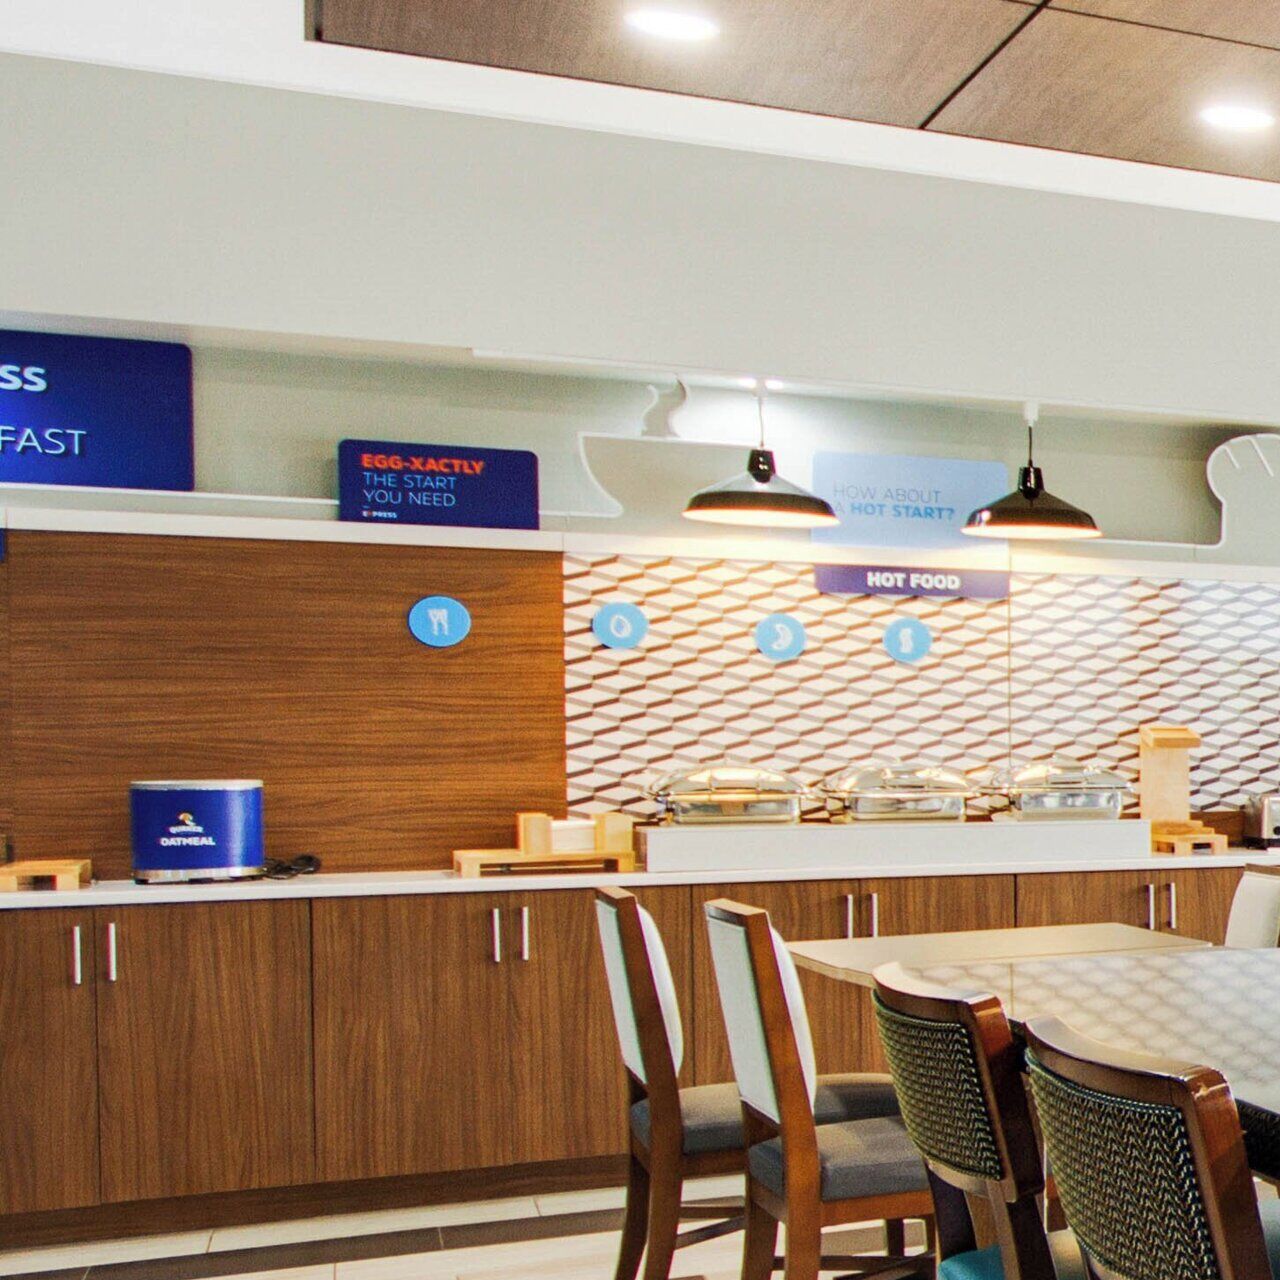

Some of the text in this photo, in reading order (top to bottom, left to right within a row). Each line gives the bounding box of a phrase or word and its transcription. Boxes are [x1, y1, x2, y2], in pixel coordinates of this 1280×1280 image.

[361, 453, 484, 474] EGG-XACTLY
[363, 472, 457, 489] THE START
[363, 490, 456, 507] YOU NEED
[833, 485, 941, 503] HOW ABOUT
[851, 504, 886, 517] HOT
[892, 506, 954, 521] START?
[867, 571, 961, 589] HOT FOOD
[160, 837, 216, 847] OATMEAL
